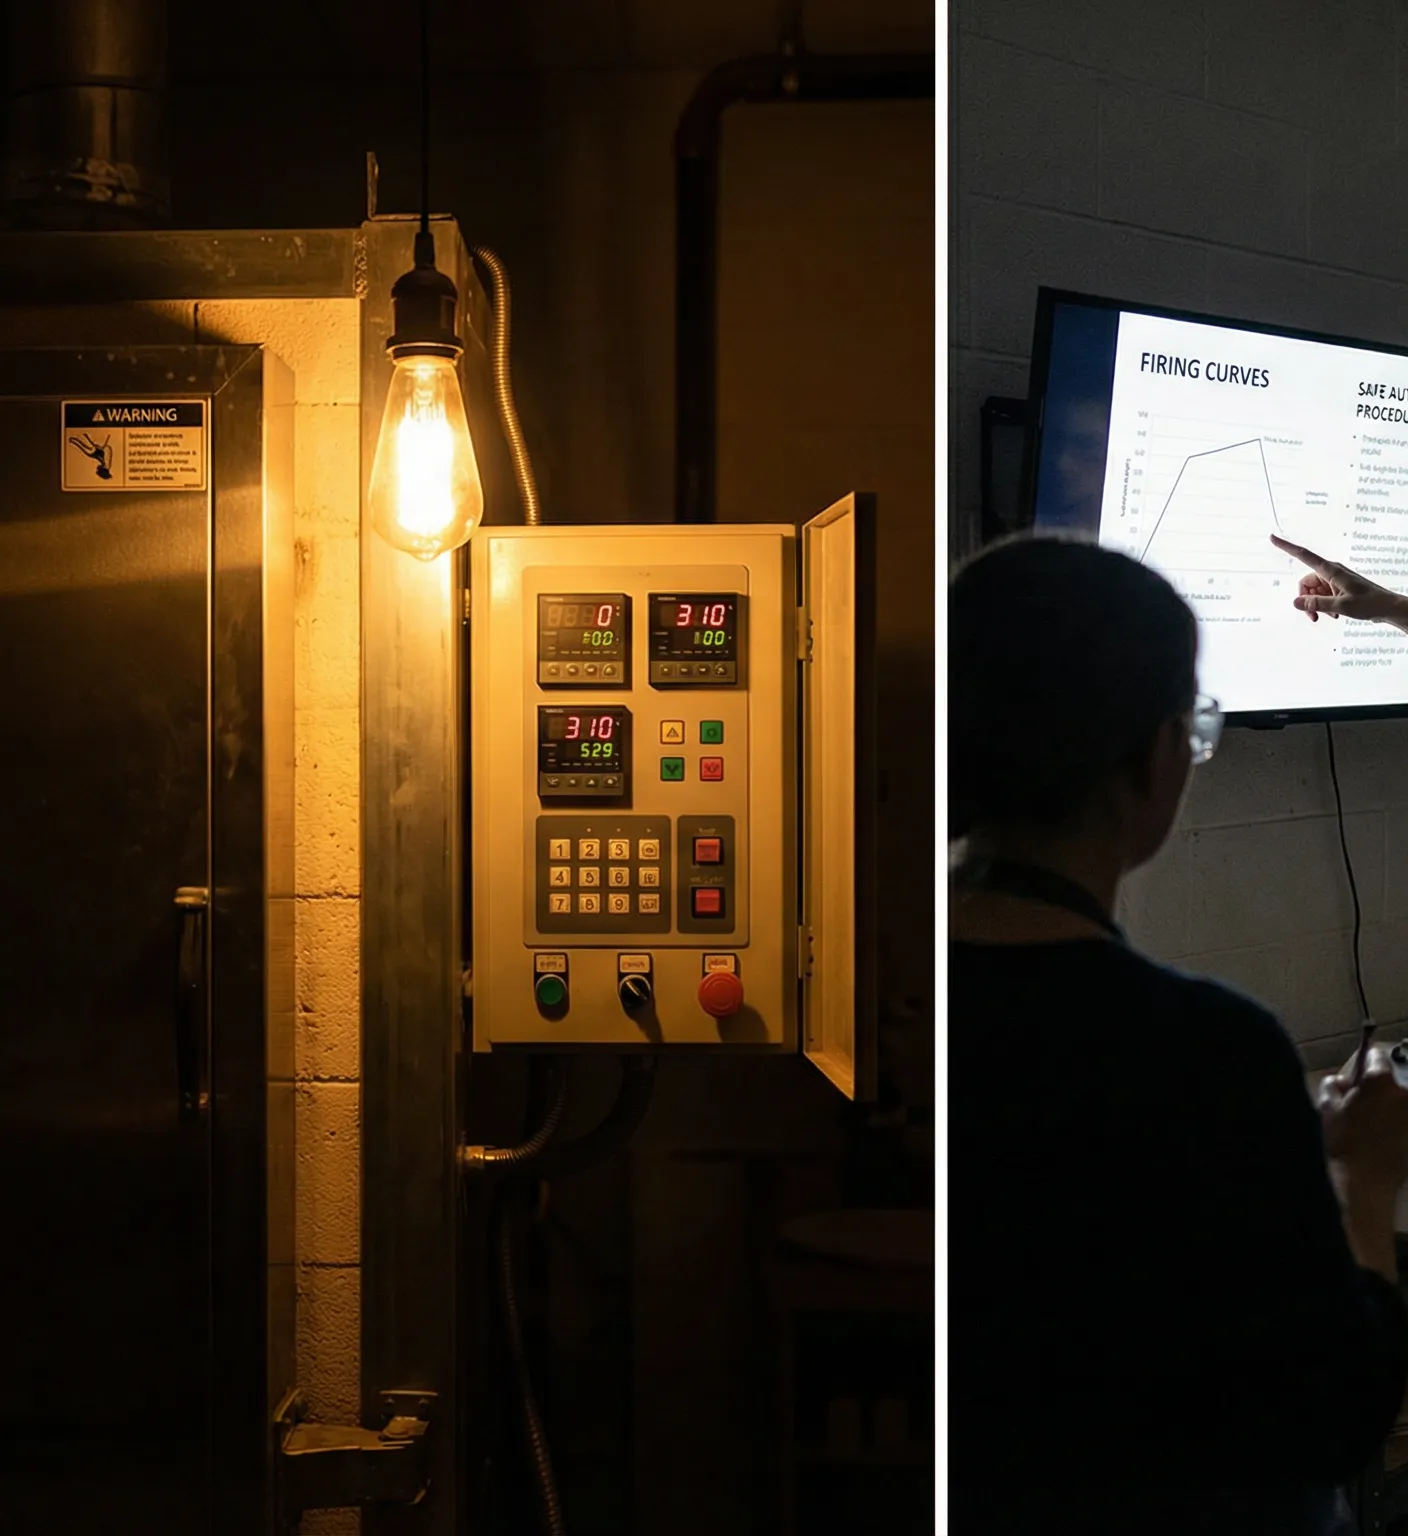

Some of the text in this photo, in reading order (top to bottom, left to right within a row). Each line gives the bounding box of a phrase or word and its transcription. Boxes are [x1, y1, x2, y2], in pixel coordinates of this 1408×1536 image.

[1140, 352, 1270, 388] FIRING CURVES
[107, 408, 178, 422] WARNING
[677, 604, 725, 626] 310
[565, 716, 613, 739] 310
[580, 742, 613, 757] 529
[585, 843, 595, 857] 2
[614, 843, 624, 856] 3
[556, 898, 564, 910] 7
[614, 898, 624, 911] 9
